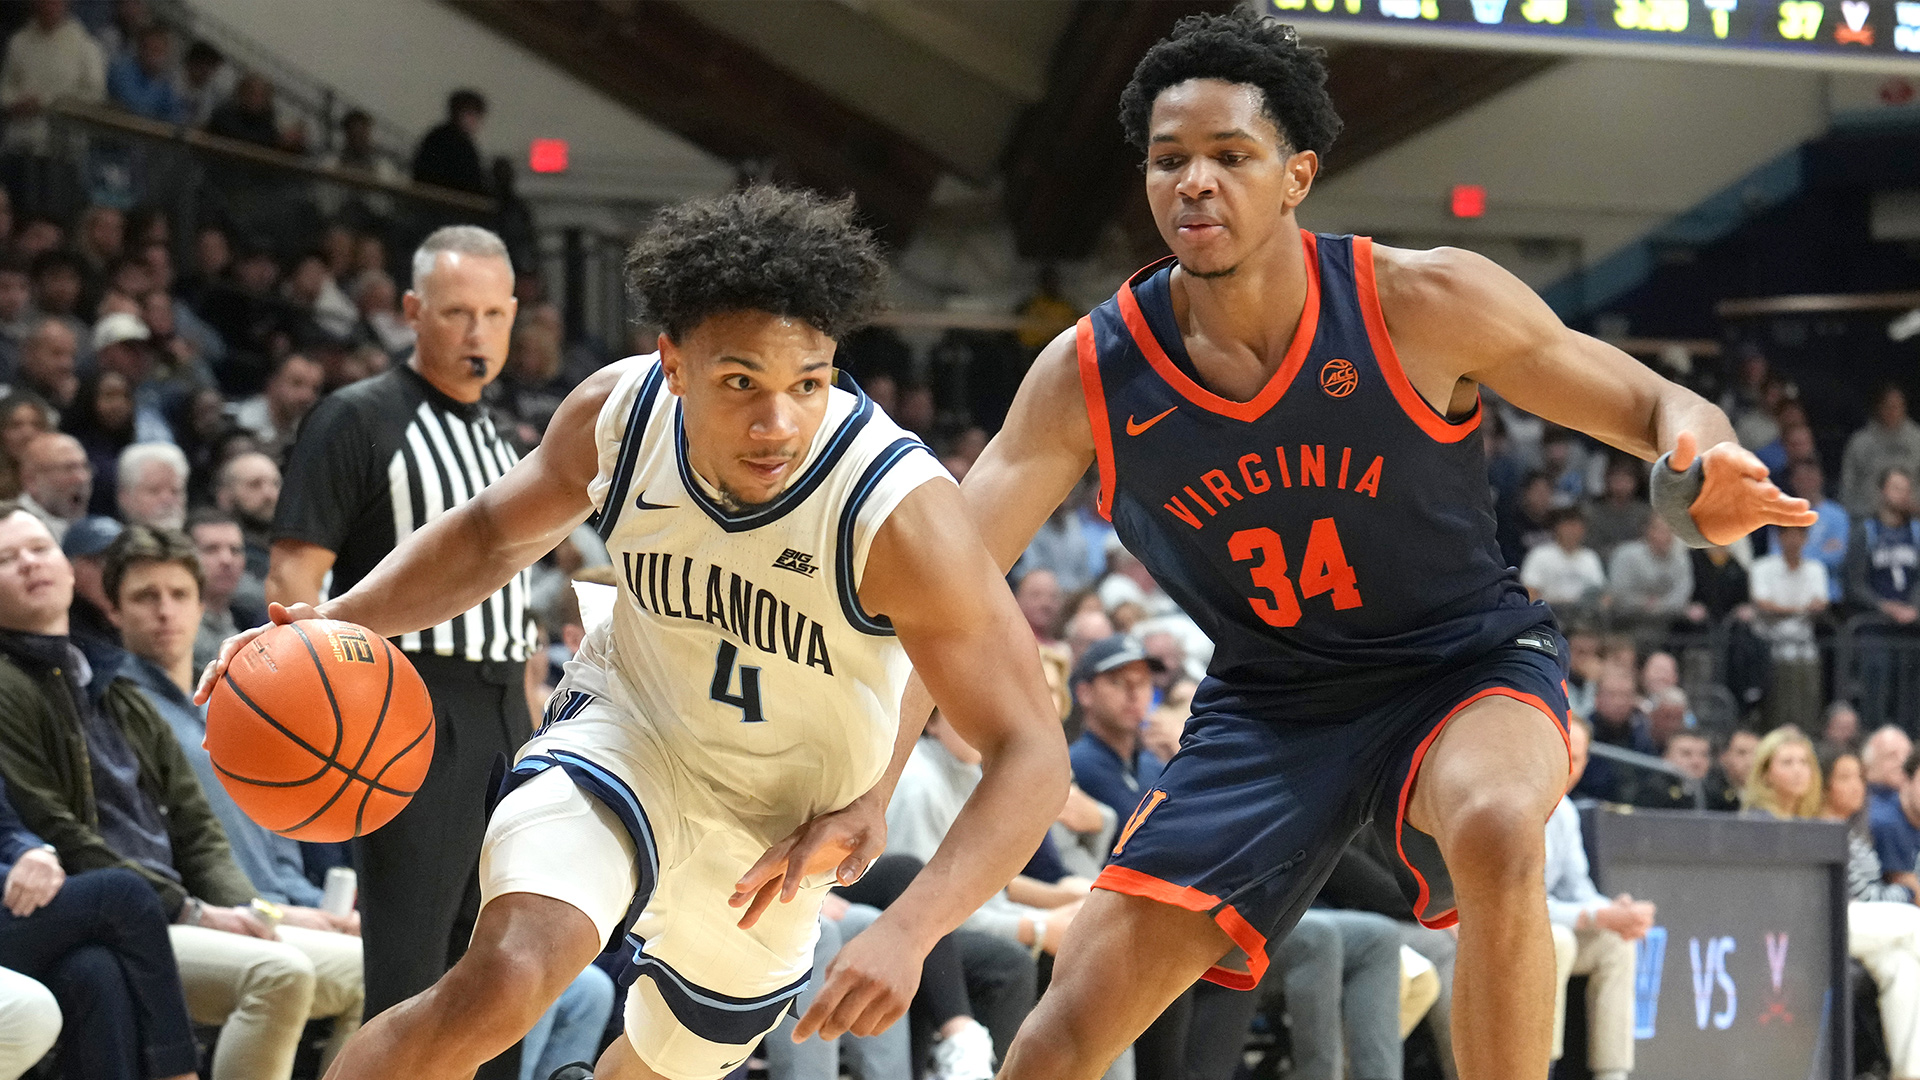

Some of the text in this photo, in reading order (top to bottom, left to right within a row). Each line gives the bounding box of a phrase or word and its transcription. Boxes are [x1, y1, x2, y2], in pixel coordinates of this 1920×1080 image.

[1778, 1, 1824, 40] 37
[1325, 366, 1355, 385] ACC
[1163, 444, 1384, 530] VIRGINIA
[775, 556, 820, 574] EAST
[781, 548, 814, 563] BIG
[1227, 517, 1363, 627] 34
[623, 552, 834, 677] VILLANOVA
[709, 638, 769, 723] 4
[1689, 936, 1738, 1031] VS
